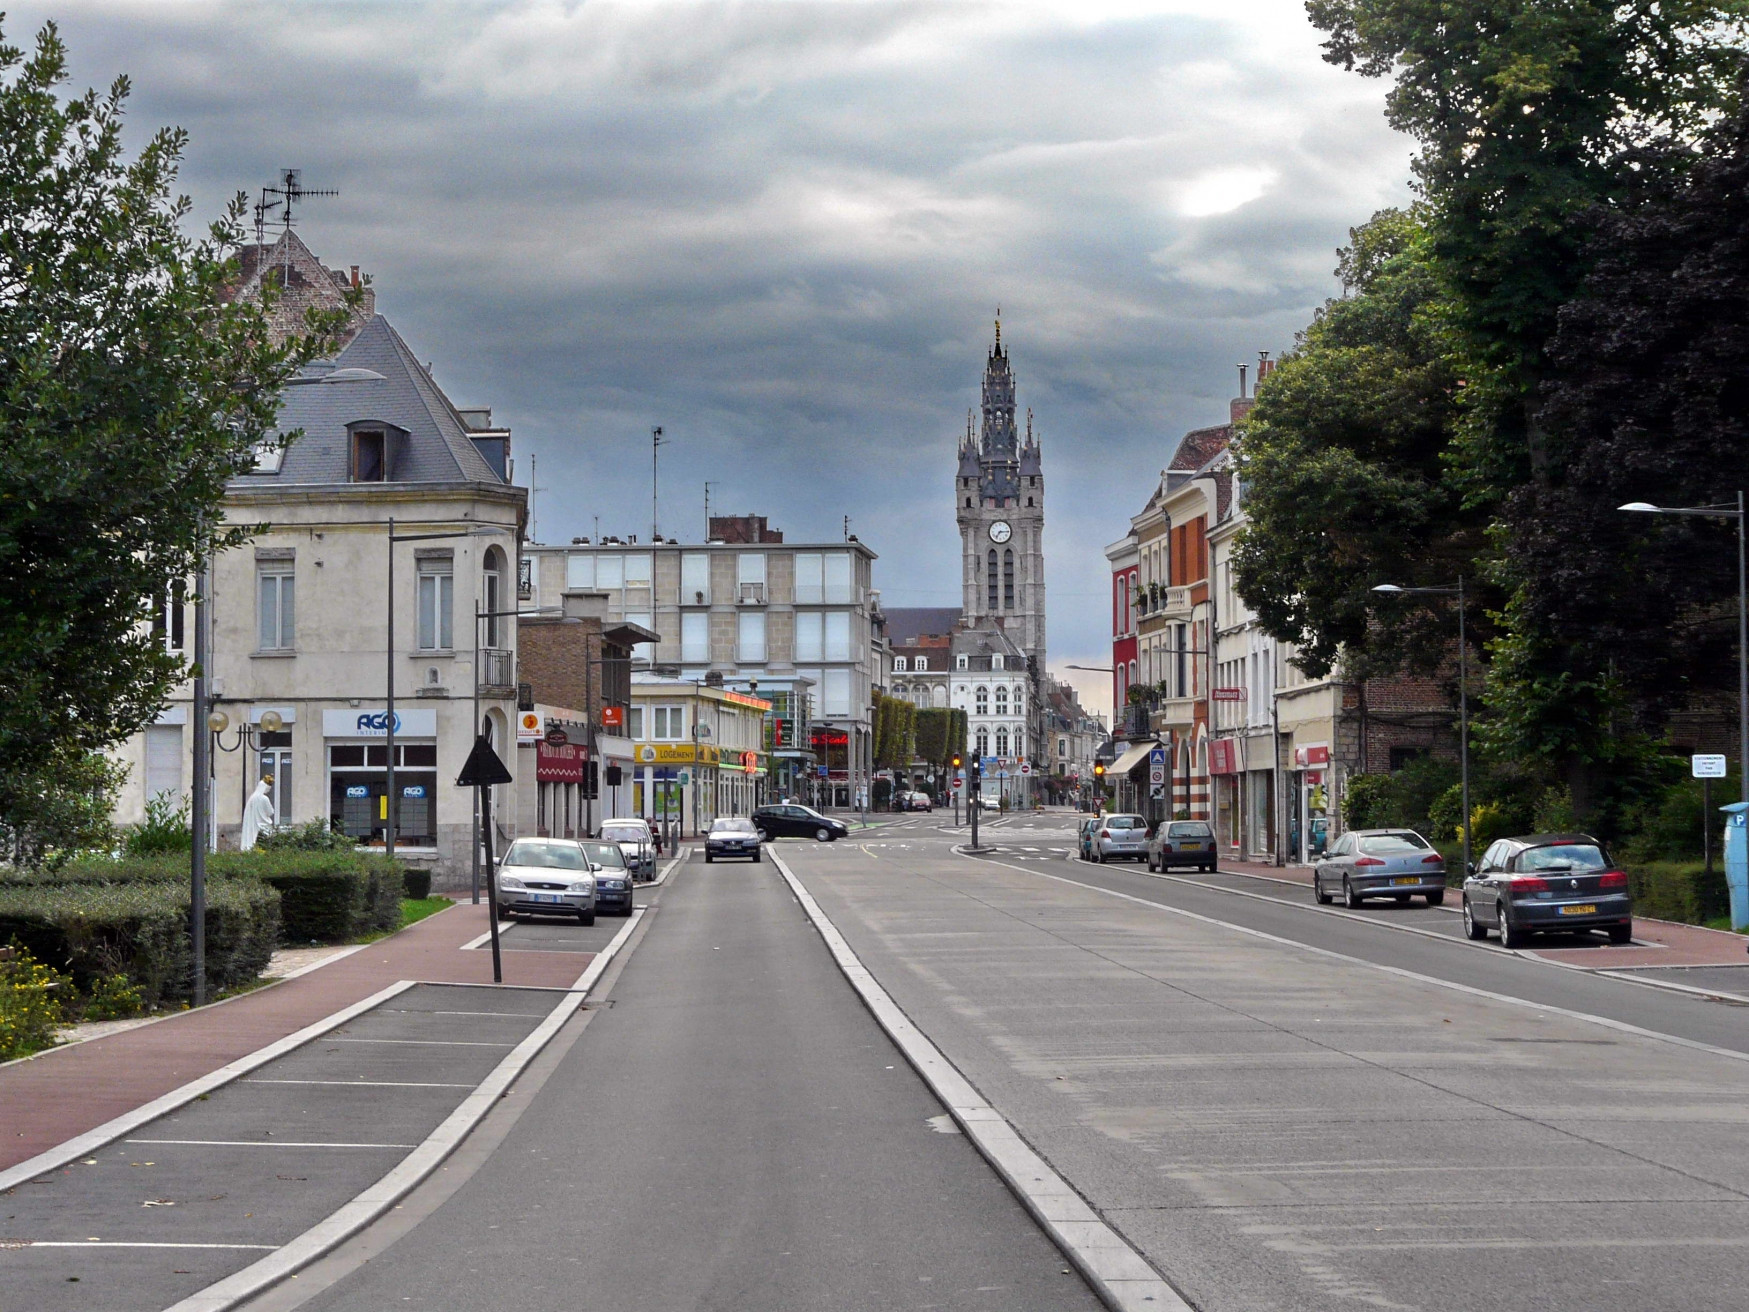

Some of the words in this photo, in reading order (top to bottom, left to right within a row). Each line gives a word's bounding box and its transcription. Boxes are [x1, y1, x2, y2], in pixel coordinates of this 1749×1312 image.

[357, 713, 397, 730] AGO
[660, 750, 694, 758] LOGEMENT
[347, 786, 365, 795] AGO
[404, 786, 422, 795] AGO
[1736, 815, 1744, 825] P
